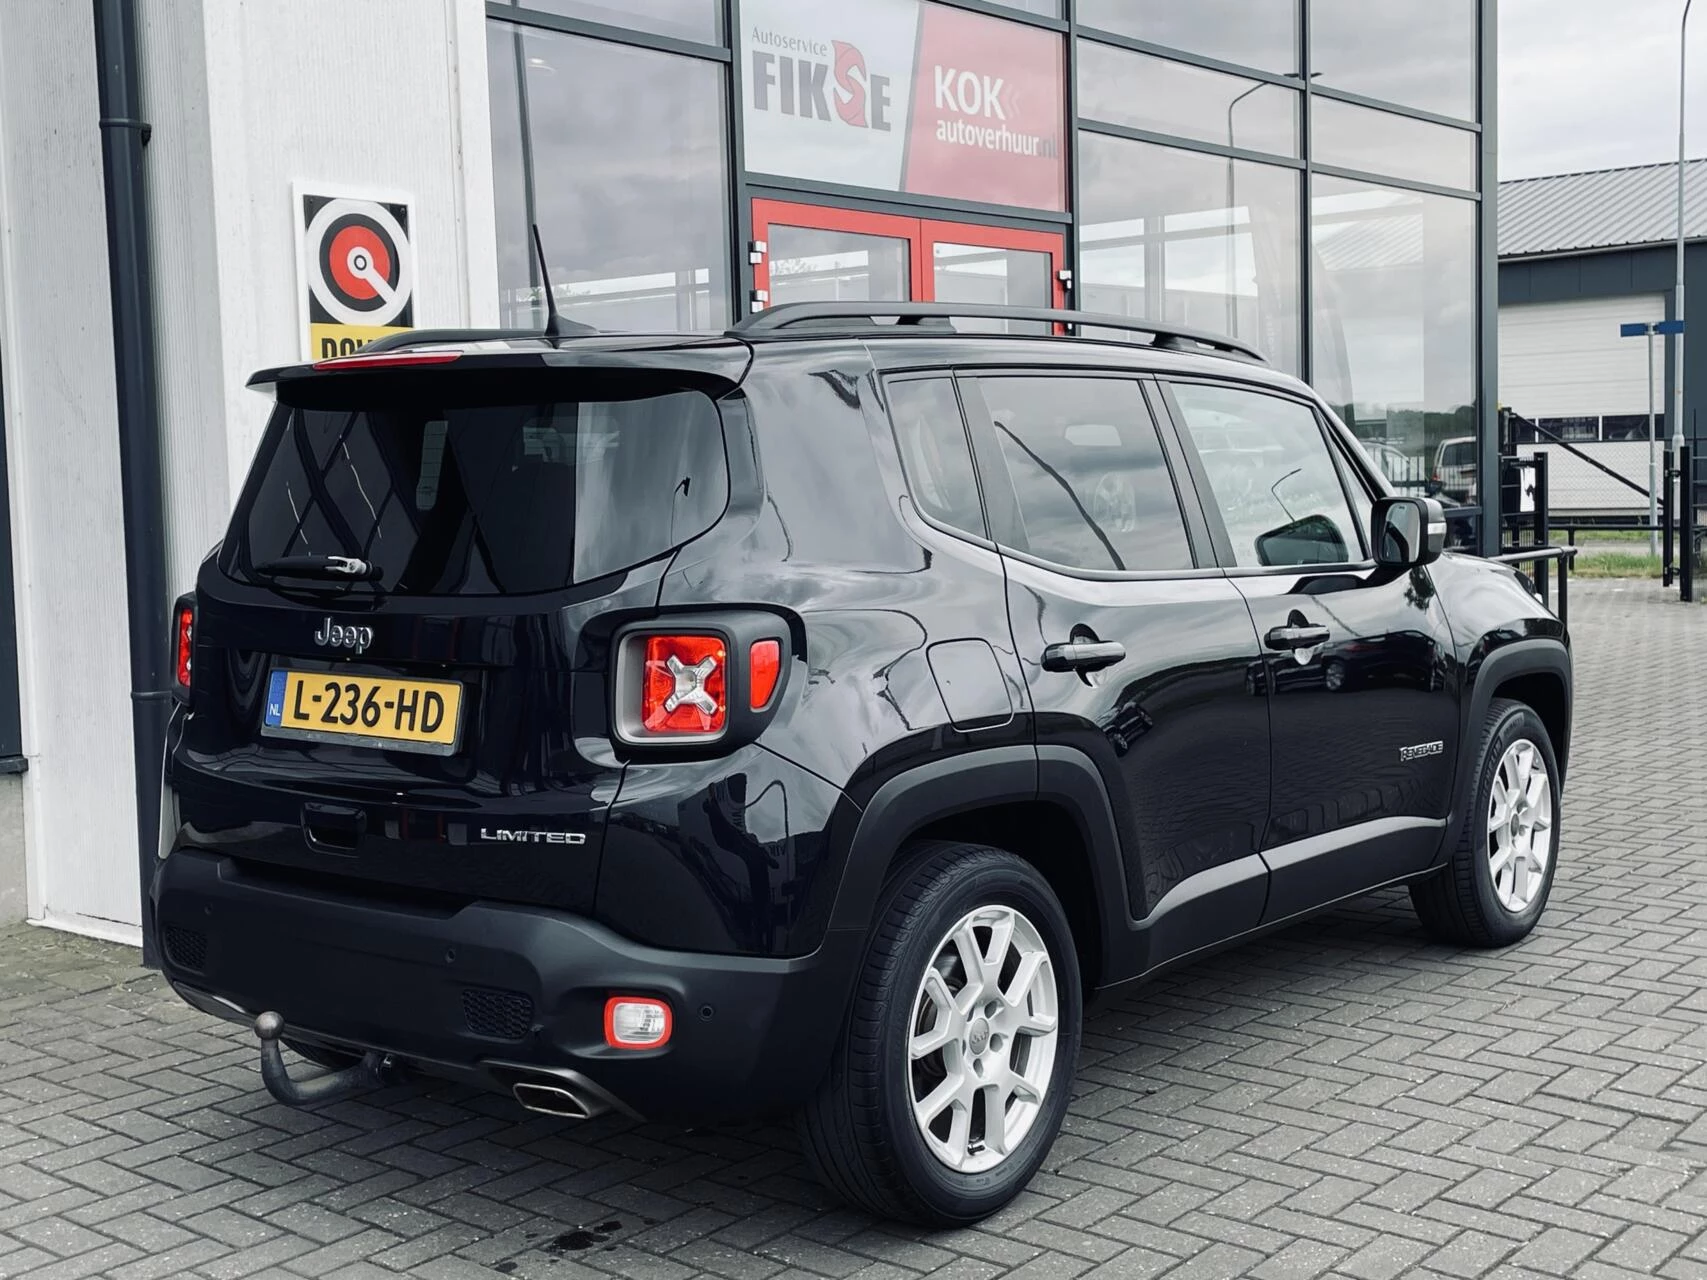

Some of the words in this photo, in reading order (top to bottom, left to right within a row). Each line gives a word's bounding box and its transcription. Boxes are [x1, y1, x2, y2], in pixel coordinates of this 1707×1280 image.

[752, 25, 828, 57] Autoservice
[752, 39, 892, 132] FIKSE
[934, 64, 1006, 121] KOK
[314, 616, 374, 655] Jeep
[269, 703, 281, 717] NL
[293, 680, 445, 734] L-236-HD
[1399, 740, 1443, 762] RENEGADE
[480, 827, 586, 845] LIMITED
